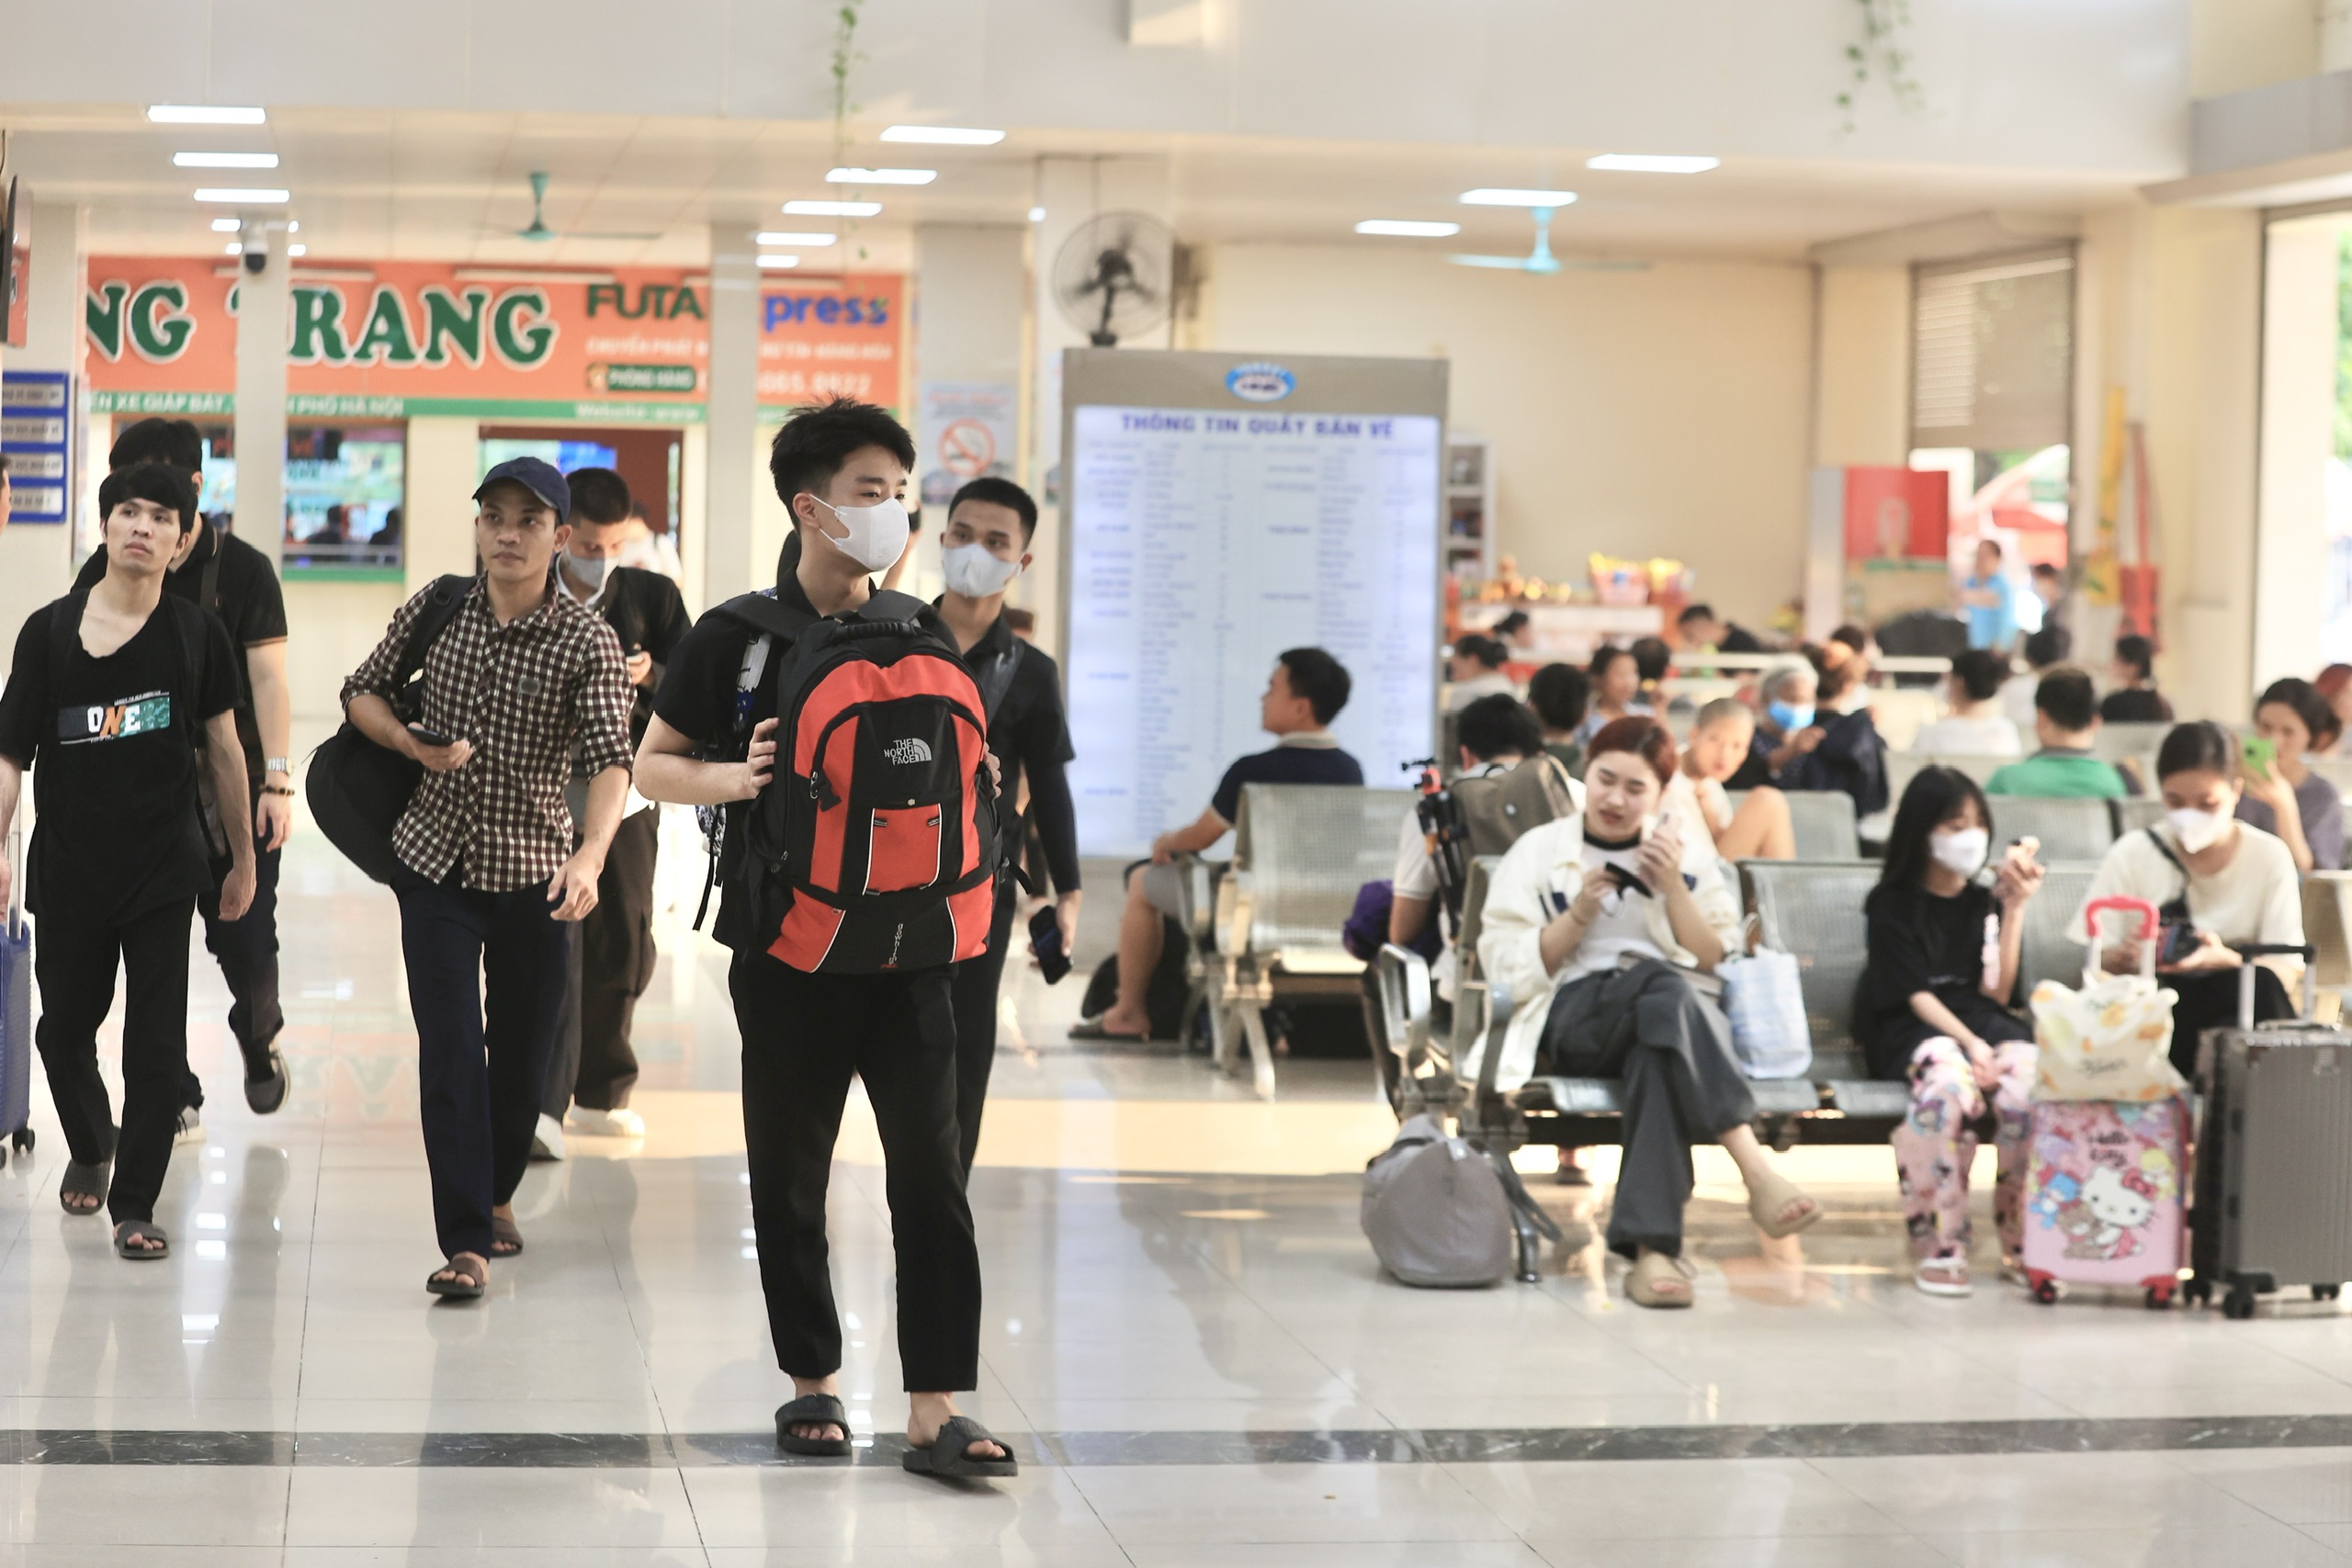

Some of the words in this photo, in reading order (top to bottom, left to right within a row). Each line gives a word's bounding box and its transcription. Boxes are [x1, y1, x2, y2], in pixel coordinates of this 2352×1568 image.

[585, 284, 706, 320] FUTA
[226, 283, 559, 368] RANG
[1122, 412, 1195, 432] THÔNG
[1204, 416, 1238, 433] TIN
[1315, 415, 1361, 435] BÁN
[87, 705, 141, 737] ONE
[883, 744, 914, 758] NORTH
[893, 739, 912, 750] THE
[892, 754, 916, 765] FACE
